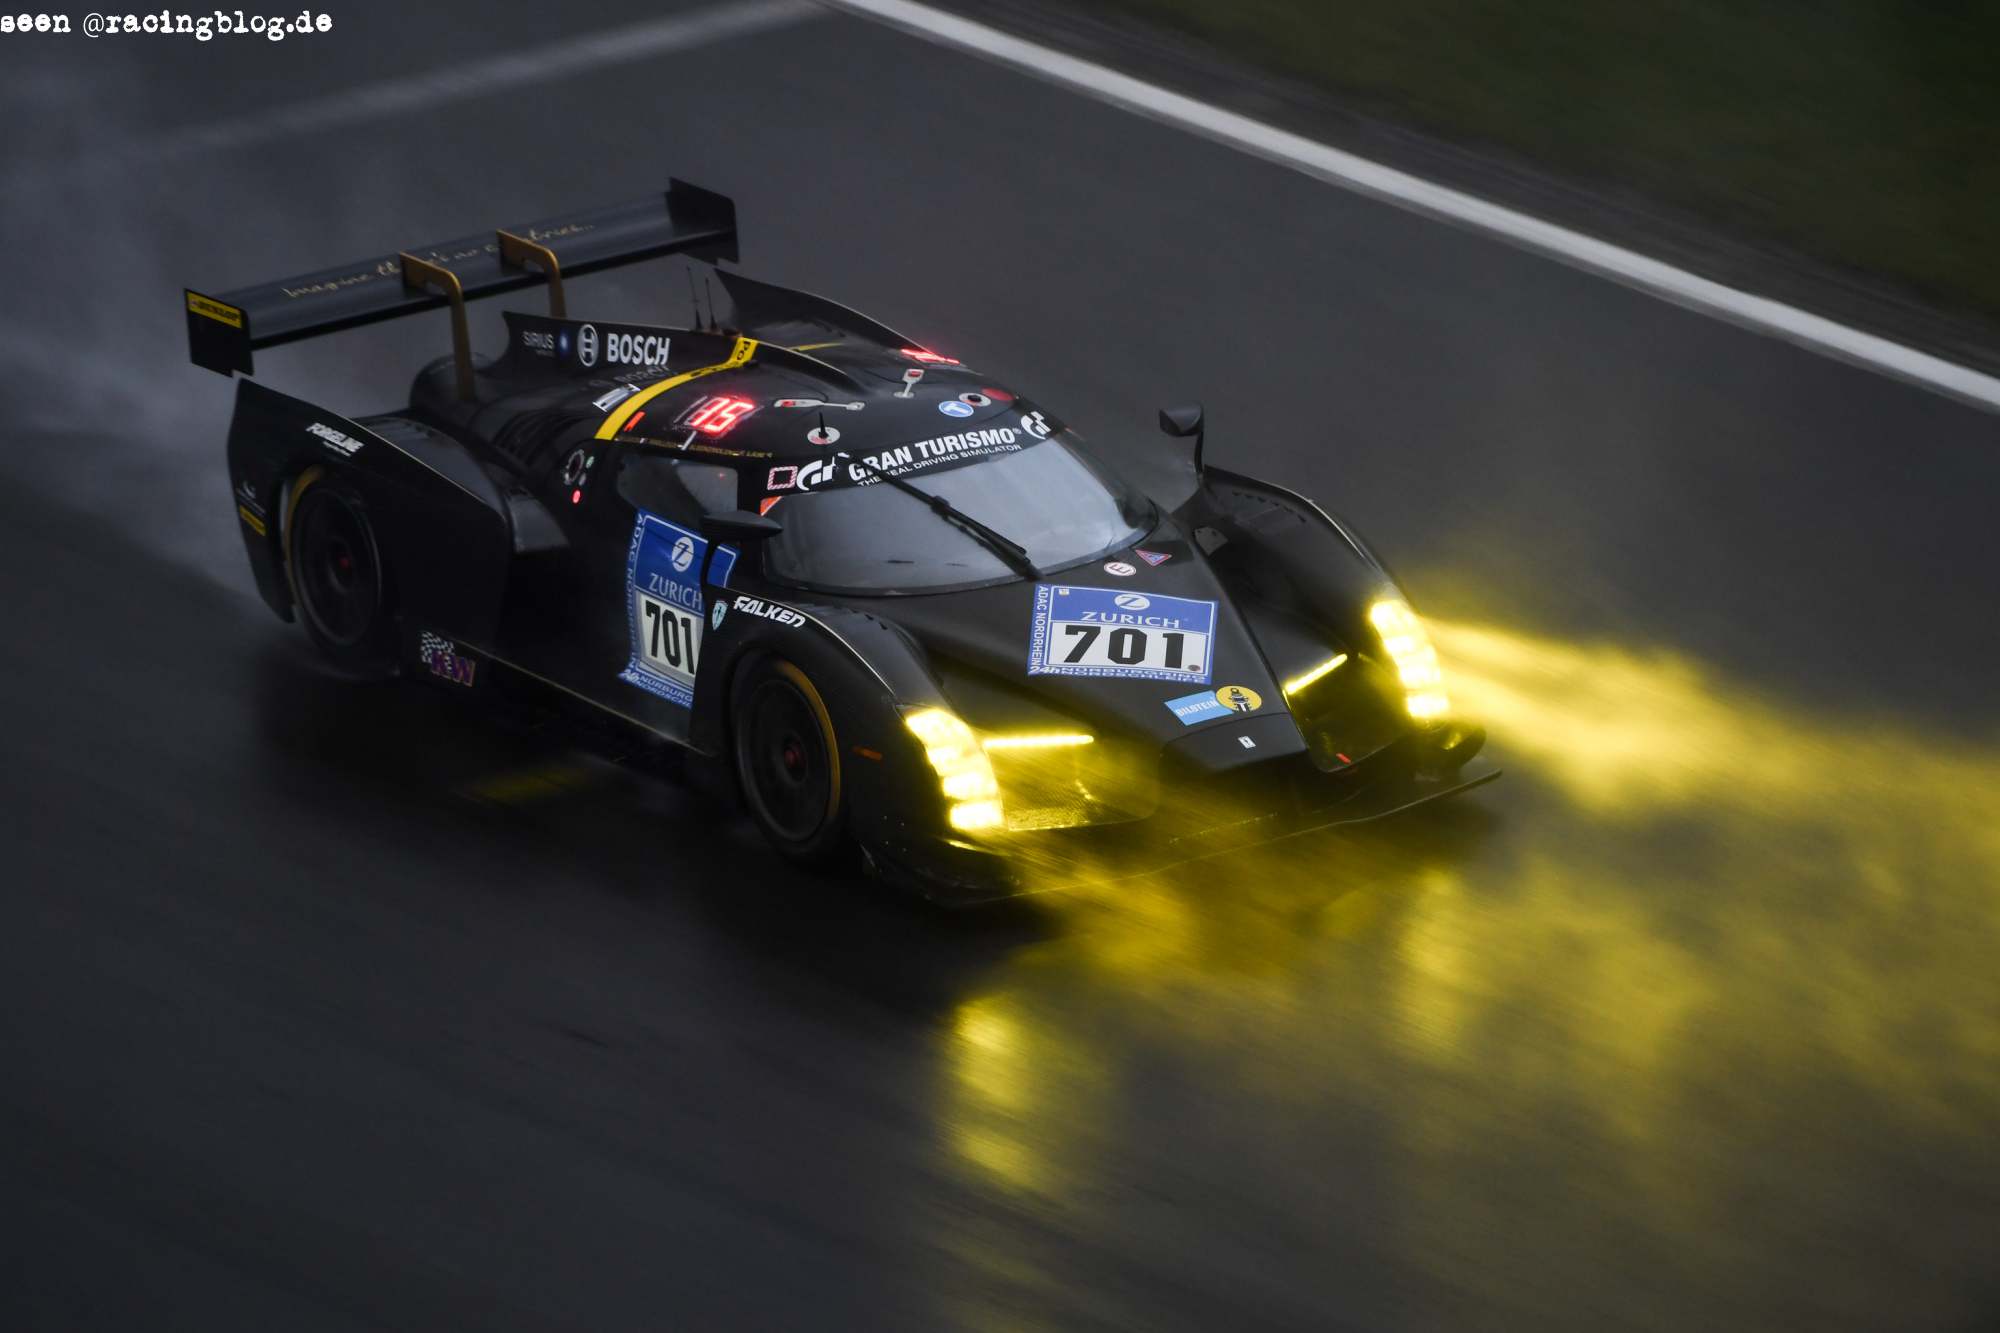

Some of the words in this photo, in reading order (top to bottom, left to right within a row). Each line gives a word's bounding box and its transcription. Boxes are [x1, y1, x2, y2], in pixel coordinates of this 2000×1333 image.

[607, 333, 671, 366] BOSCH
[848, 446, 913, 481] GRAN
[914, 428, 1016, 459] TURISMO
[887, 466, 914, 477] EAL
[913, 453, 960, 470] DRIVING
[960, 443, 1022, 459] SIMULATOR
[649, 572, 703, 612] ZURICH
[1036, 585, 1049, 611] ADAC
[732, 595, 806, 628] FALKEN
[1080, 611, 1180, 629] ZURICH
[645, 599, 695, 675] 701
[1031, 612, 1047, 668] NORDRHEIN
[1063, 624, 1185, 669] 701
